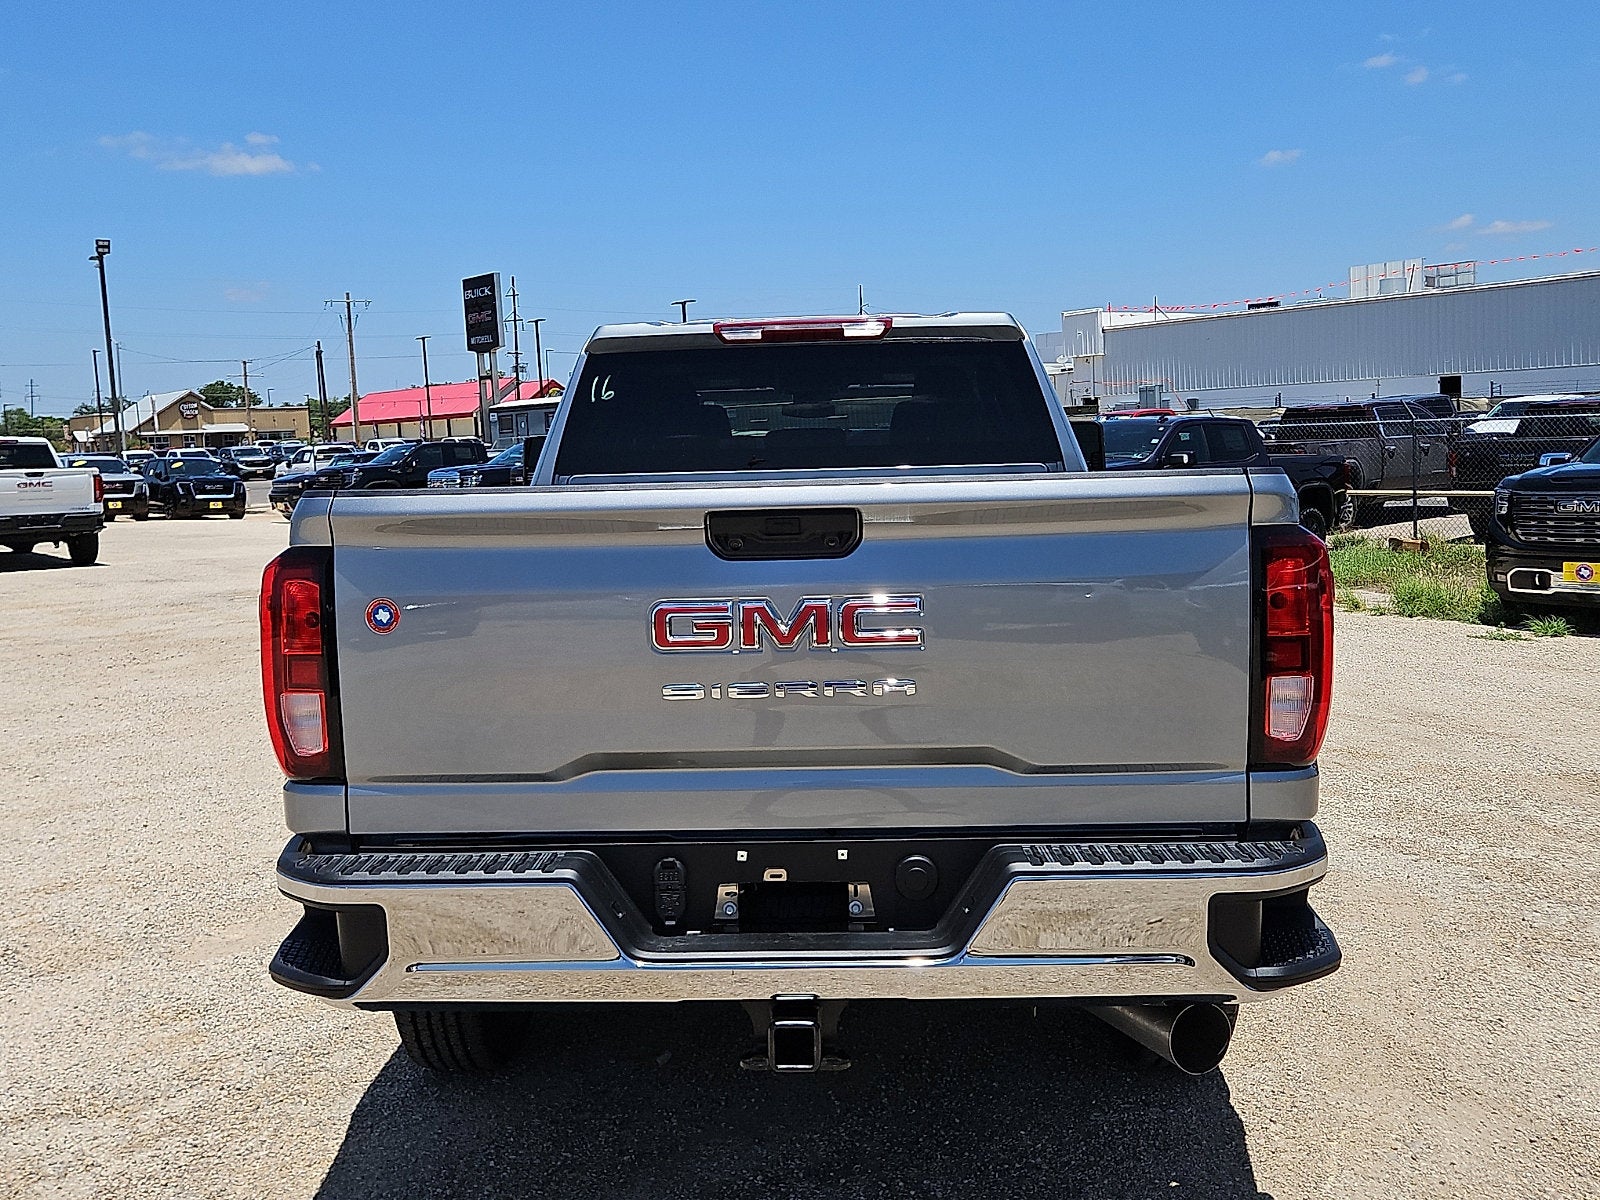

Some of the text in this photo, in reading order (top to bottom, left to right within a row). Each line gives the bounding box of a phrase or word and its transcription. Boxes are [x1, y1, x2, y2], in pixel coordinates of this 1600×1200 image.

[464, 285, 492, 300] BUICK
[467, 310, 492, 324] GMC
[591, 374, 615, 403] 16
[1557, 500, 1600, 512] GM
[649, 594, 925, 653] GMC
[661, 678, 917, 700] SIERRA
